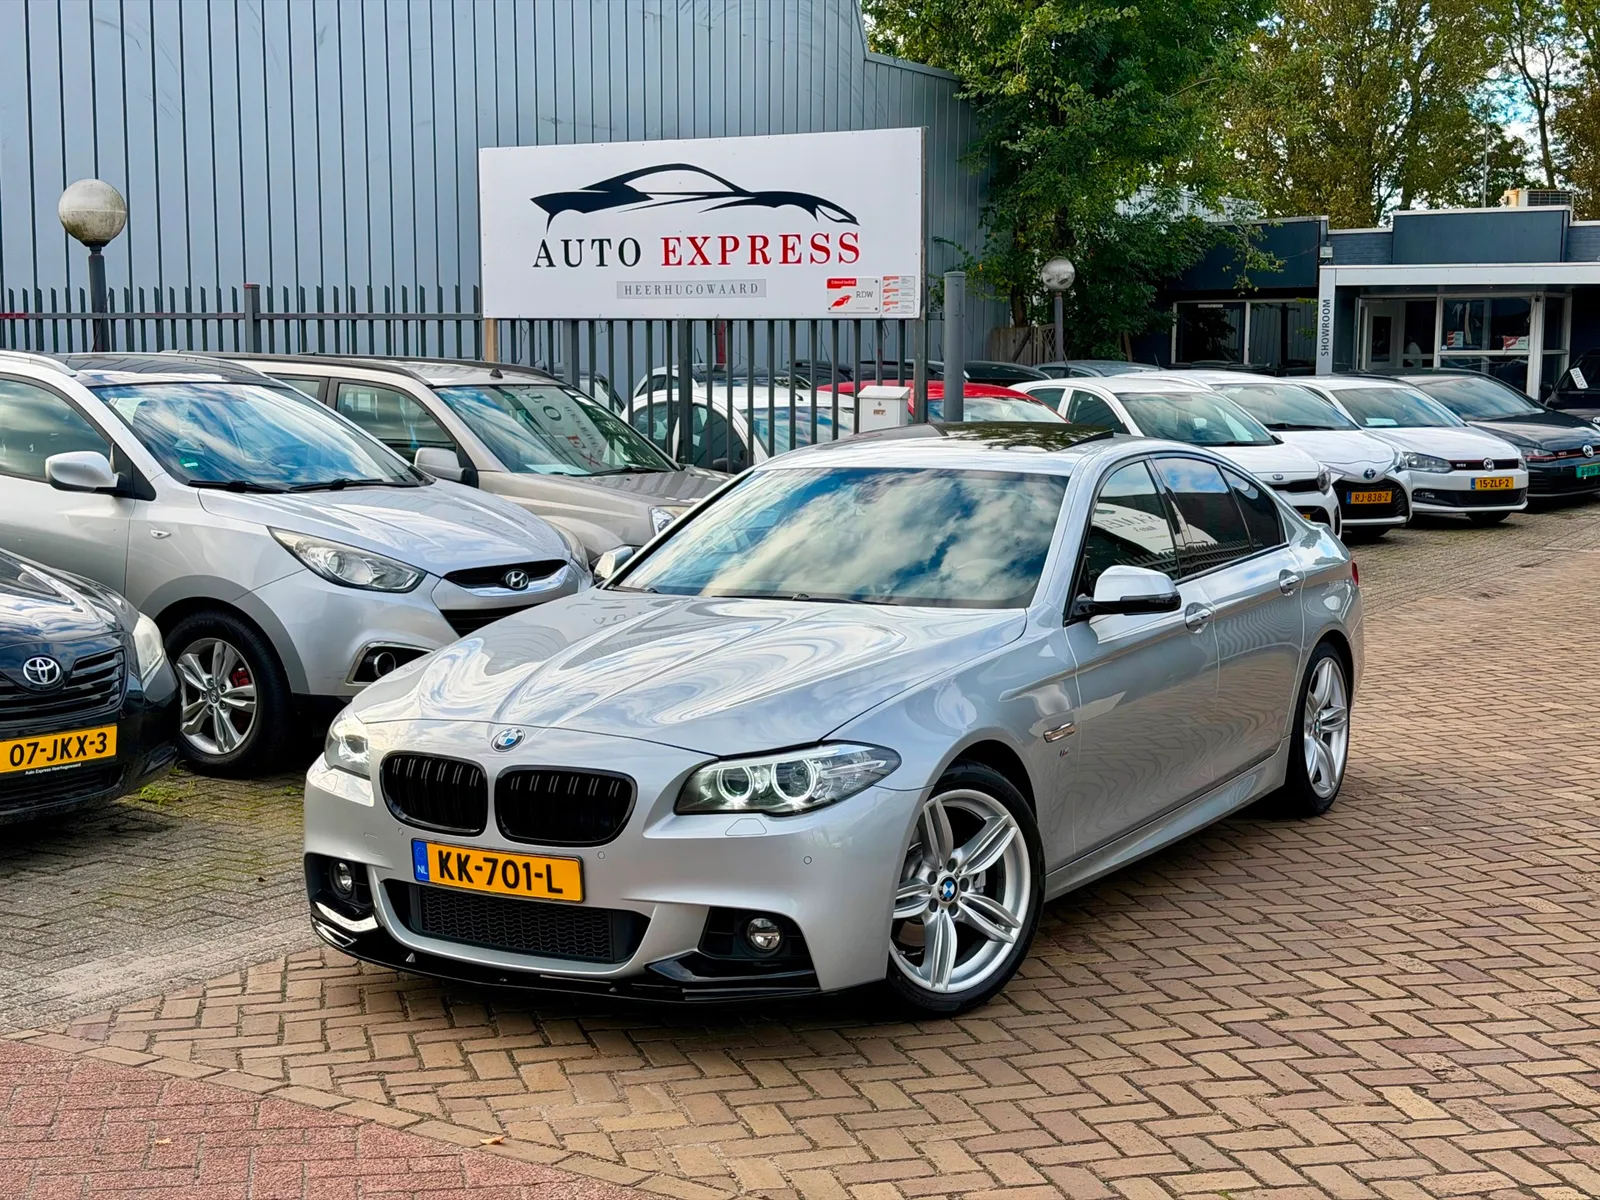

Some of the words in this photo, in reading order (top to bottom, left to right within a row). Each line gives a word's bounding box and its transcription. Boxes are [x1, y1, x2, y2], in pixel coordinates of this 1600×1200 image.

[533, 237, 642, 268] AUTO
[661, 232, 860, 267] EXPRESS
[624, 283, 759, 296] HEERHUGOWAARD
[1320, 299, 1331, 357] SHOWROOM
[1479, 478, 1510, 488] 15-ZLF-2
[1354, 492, 1389, 502] RJ-838-Z
[9, 732, 108, 767] 07-JKX-3
[417, 864, 428, 875] NL
[438, 850, 563, 894] KK-701-L
